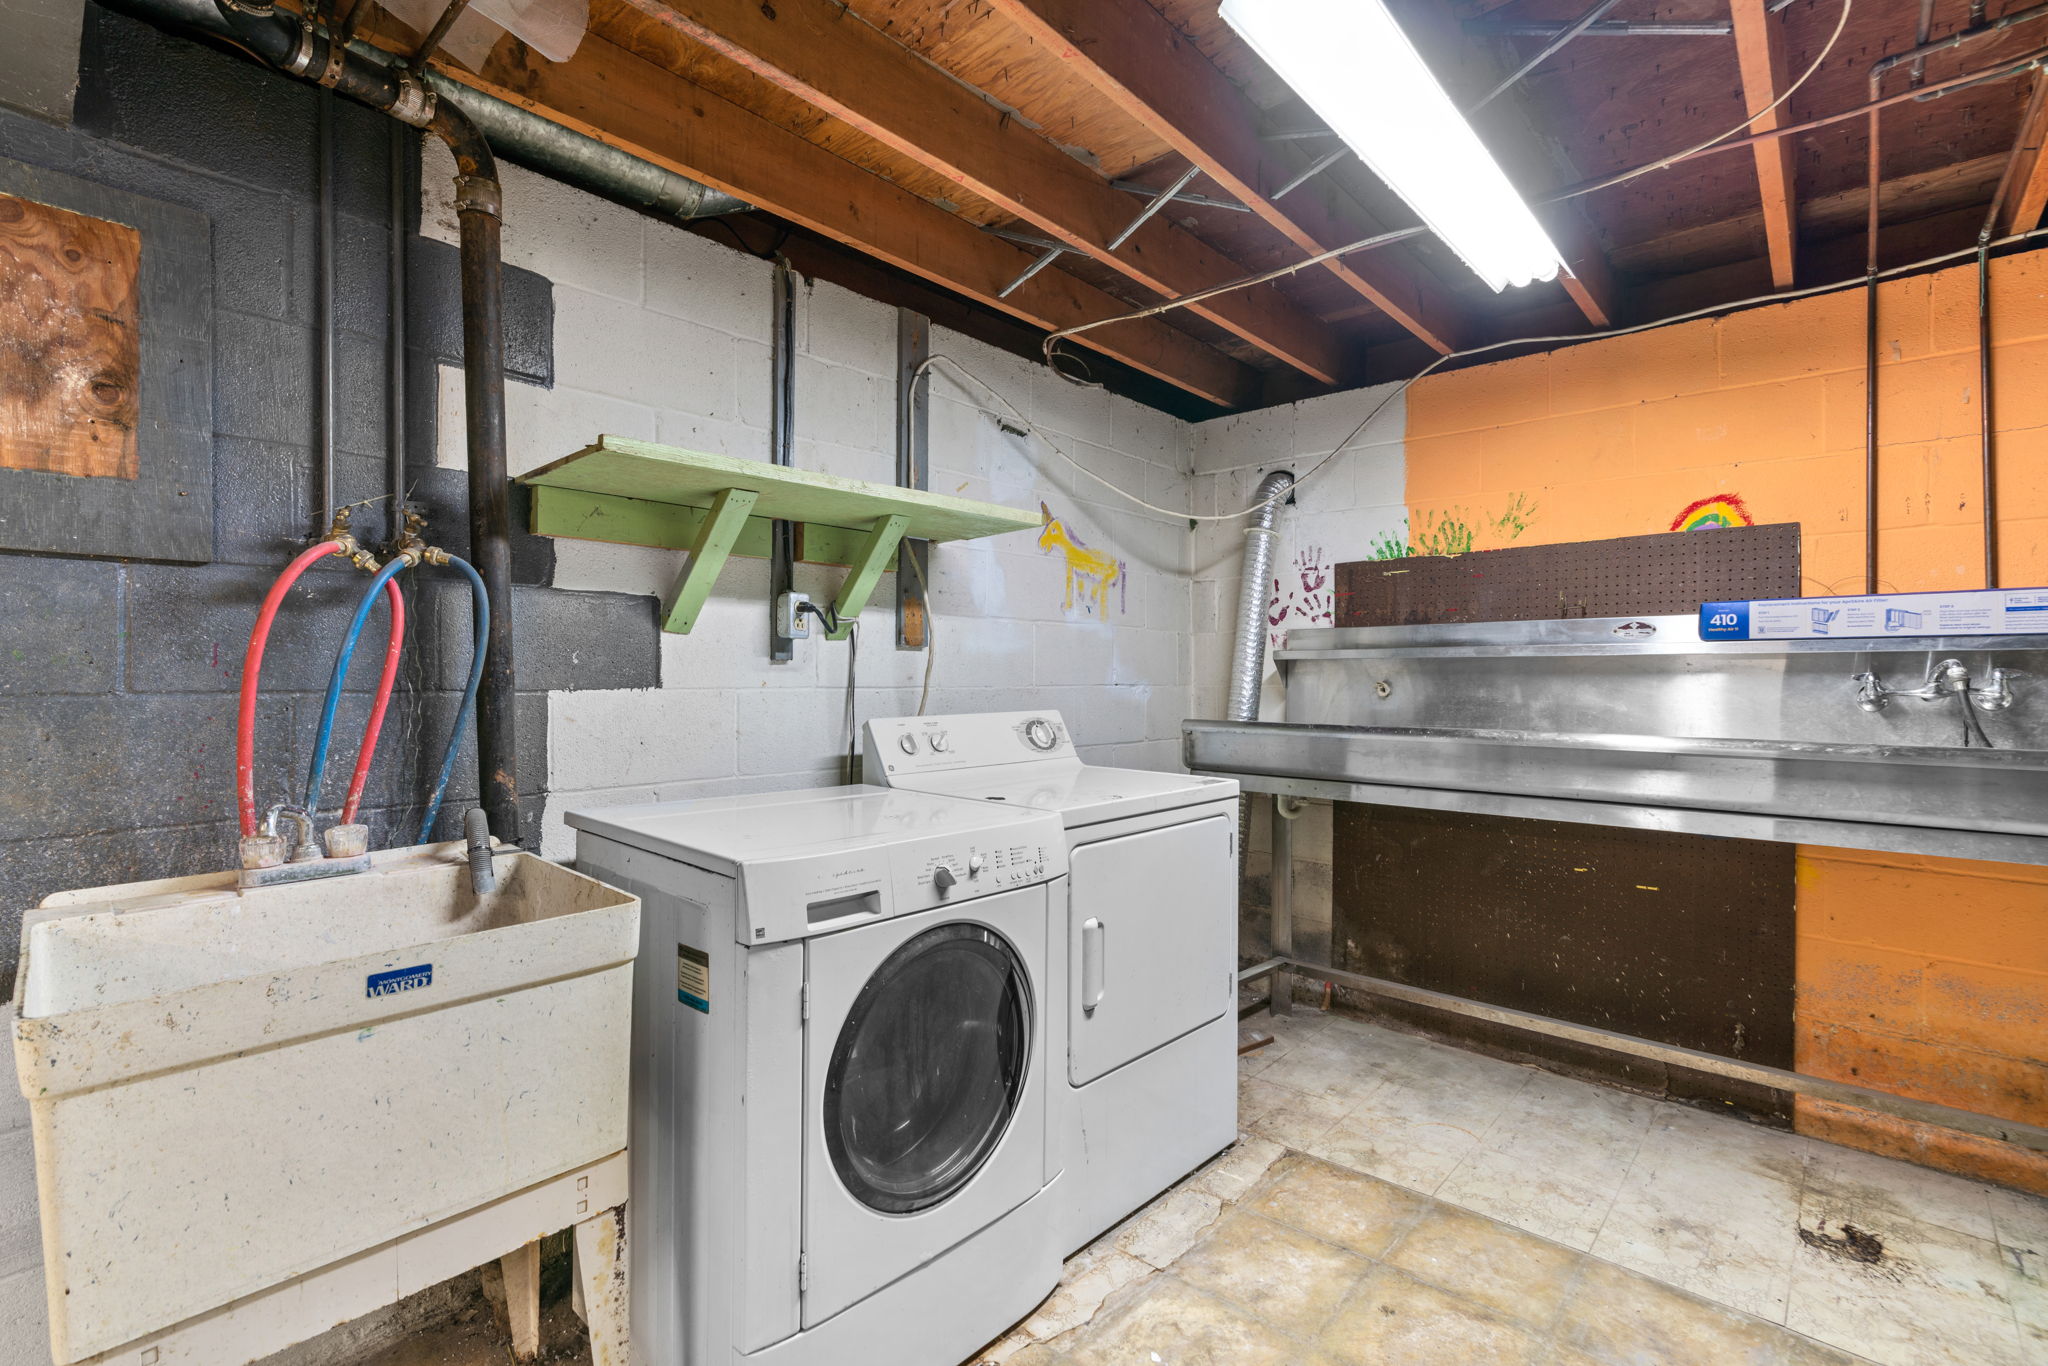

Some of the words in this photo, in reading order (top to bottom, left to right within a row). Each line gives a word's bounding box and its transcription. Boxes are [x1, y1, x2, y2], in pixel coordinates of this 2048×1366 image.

[1710, 613, 1738, 626] 410
[378, 971, 432, 986] MONTGOMERY
[368, 977, 428, 997] WARD
